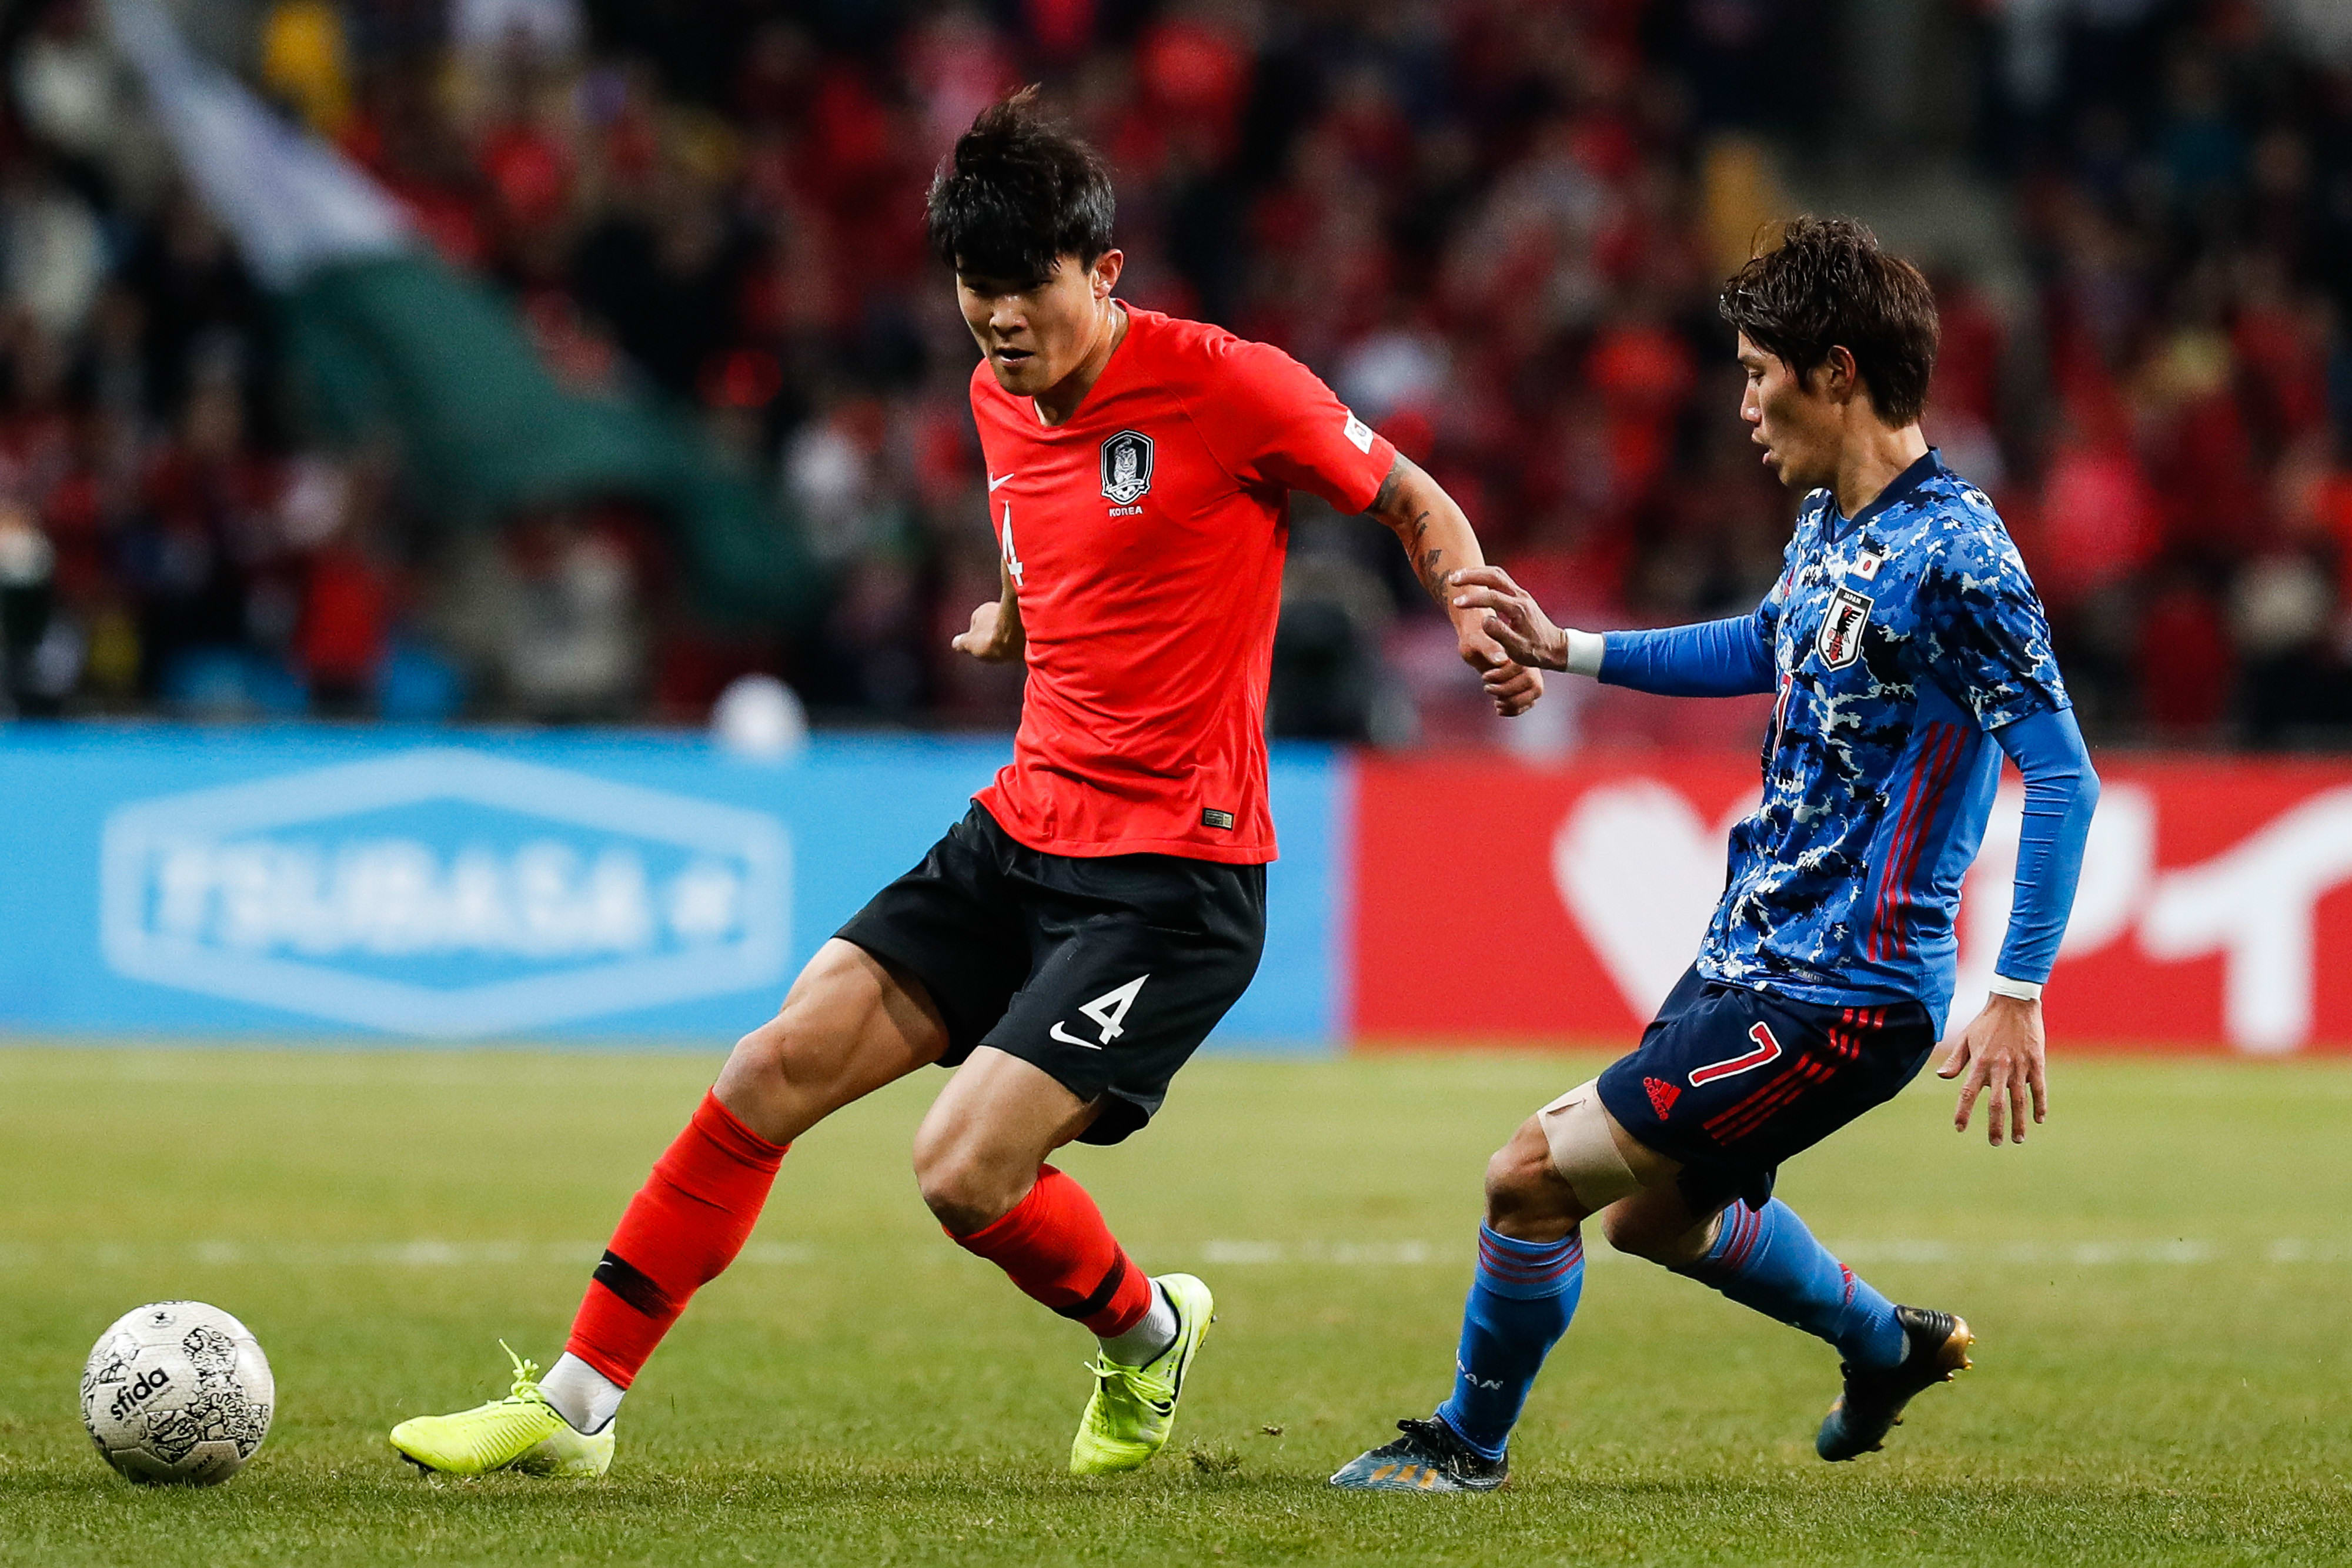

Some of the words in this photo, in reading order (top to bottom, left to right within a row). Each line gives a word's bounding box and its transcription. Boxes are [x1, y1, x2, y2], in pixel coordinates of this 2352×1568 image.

[1109, 506, 1143, 517] KOREA
[1001, 500, 1024, 587] 4
[1843, 592, 1862, 605] JAPAN
[1078, 973, 1151, 1045] 4
[1688, 1021, 1782, 1087] 7
[1643, 1076, 1669, 1121] adidas
[109, 1367, 170, 1422] sfida
